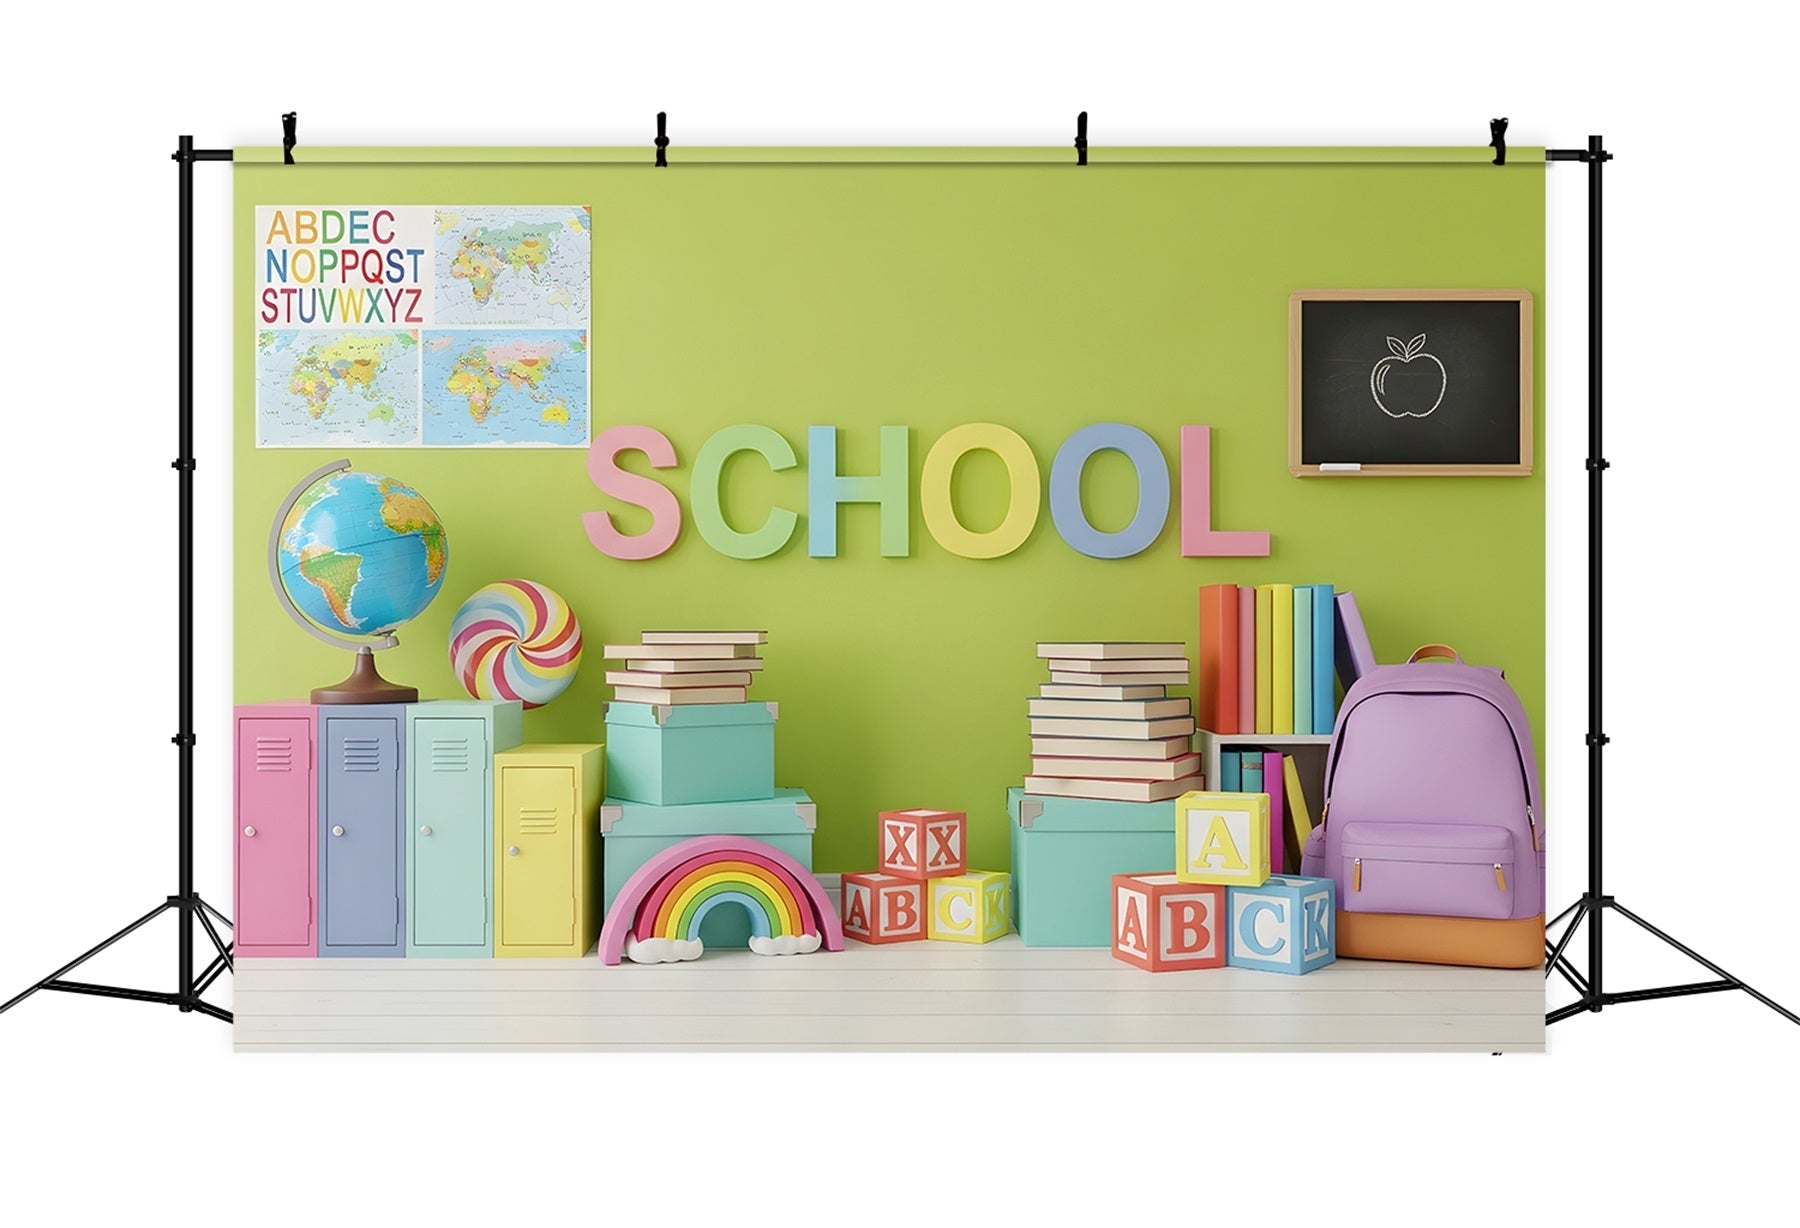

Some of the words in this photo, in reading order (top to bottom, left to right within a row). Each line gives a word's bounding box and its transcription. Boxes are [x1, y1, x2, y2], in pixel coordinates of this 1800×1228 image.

[266, 211, 395, 244] ABDEC
[267, 249, 424, 284] NOPPQST
[262, 288, 423, 323] STUVWXYZ
[582, 422, 1270, 559] SCHOOL
[1193, 817, 1247, 869] A
